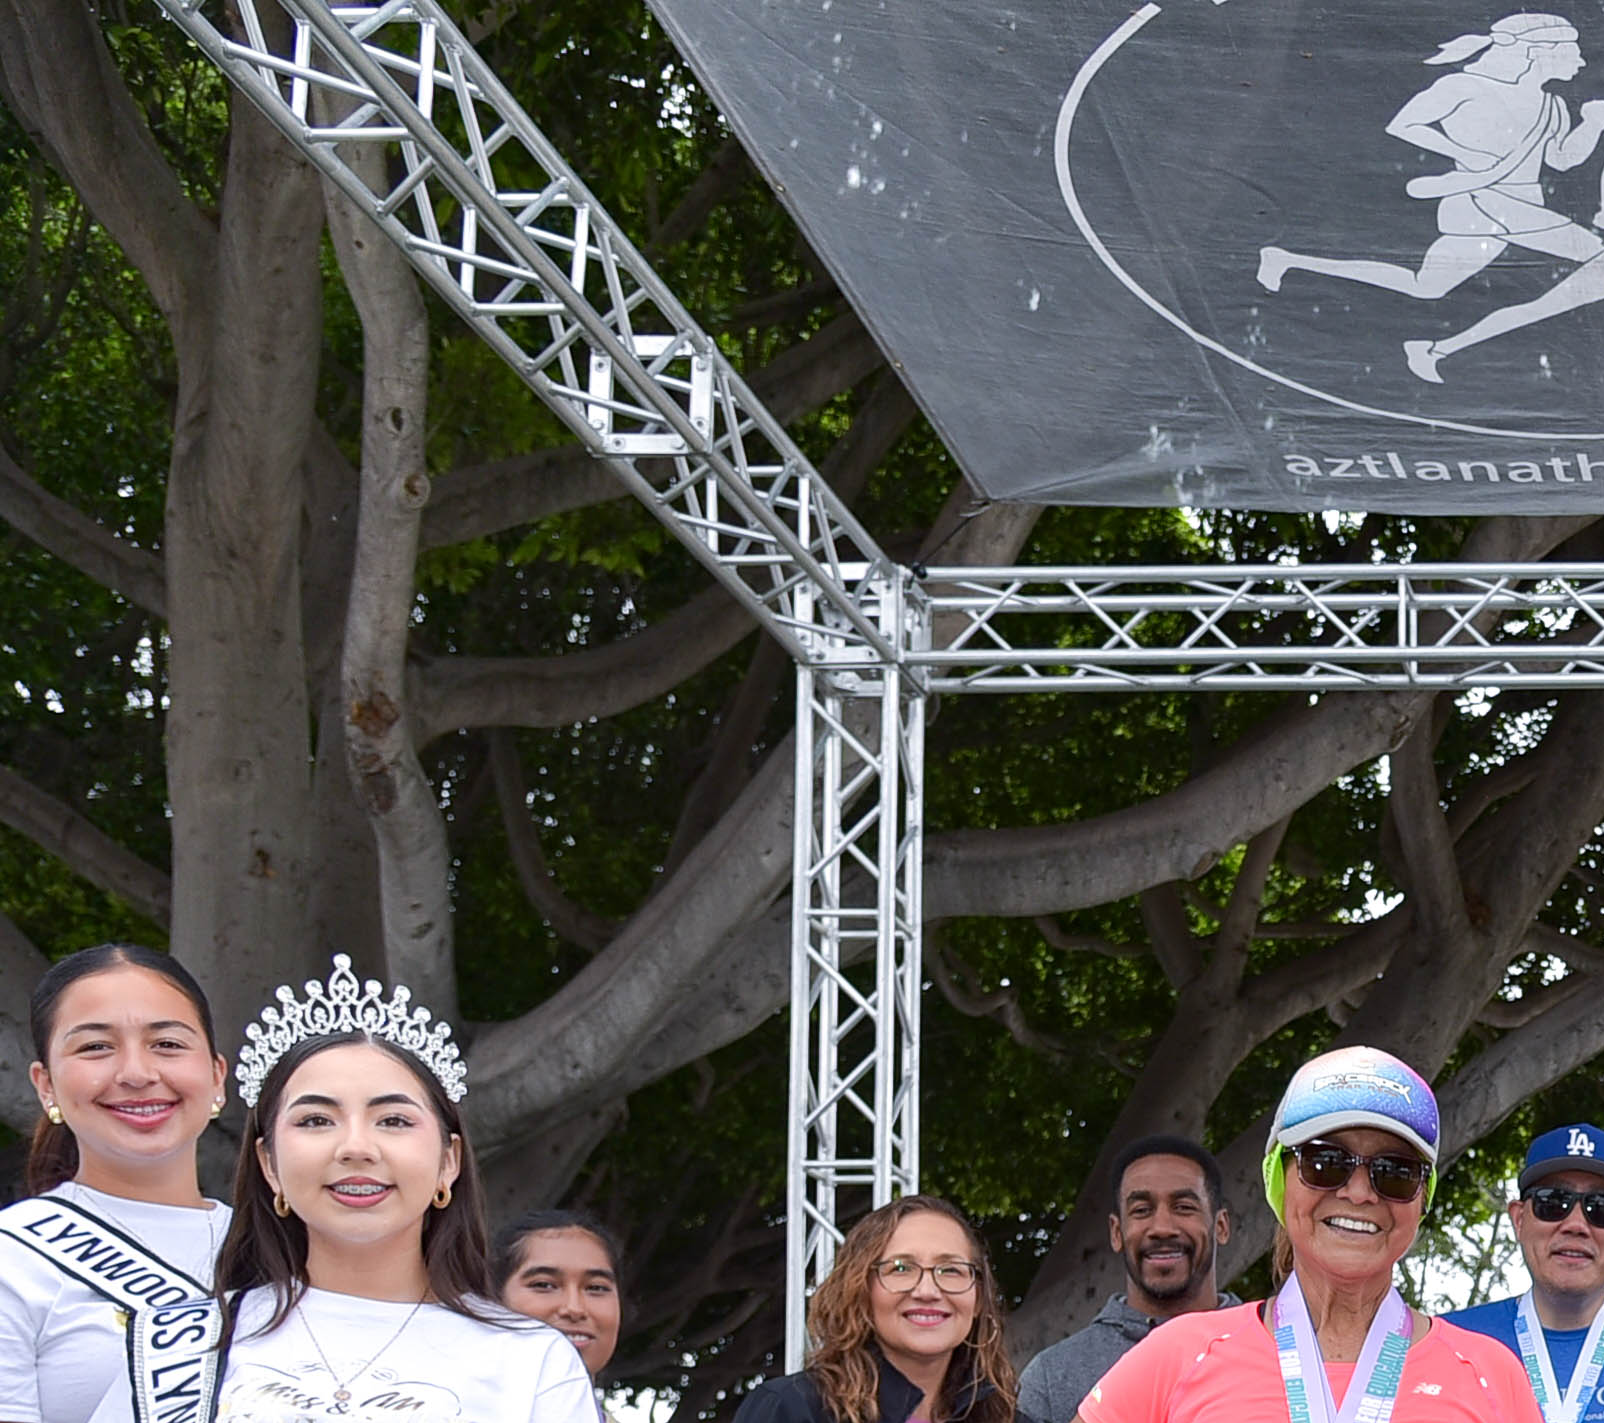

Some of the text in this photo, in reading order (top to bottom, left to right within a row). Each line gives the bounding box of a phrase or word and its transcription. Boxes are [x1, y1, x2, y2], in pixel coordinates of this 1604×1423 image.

[1566, 1128, 1595, 1157] LA
[1274, 1325, 1296, 1350] RUN
[1366, 1331, 1407, 1398] EDUCATION
